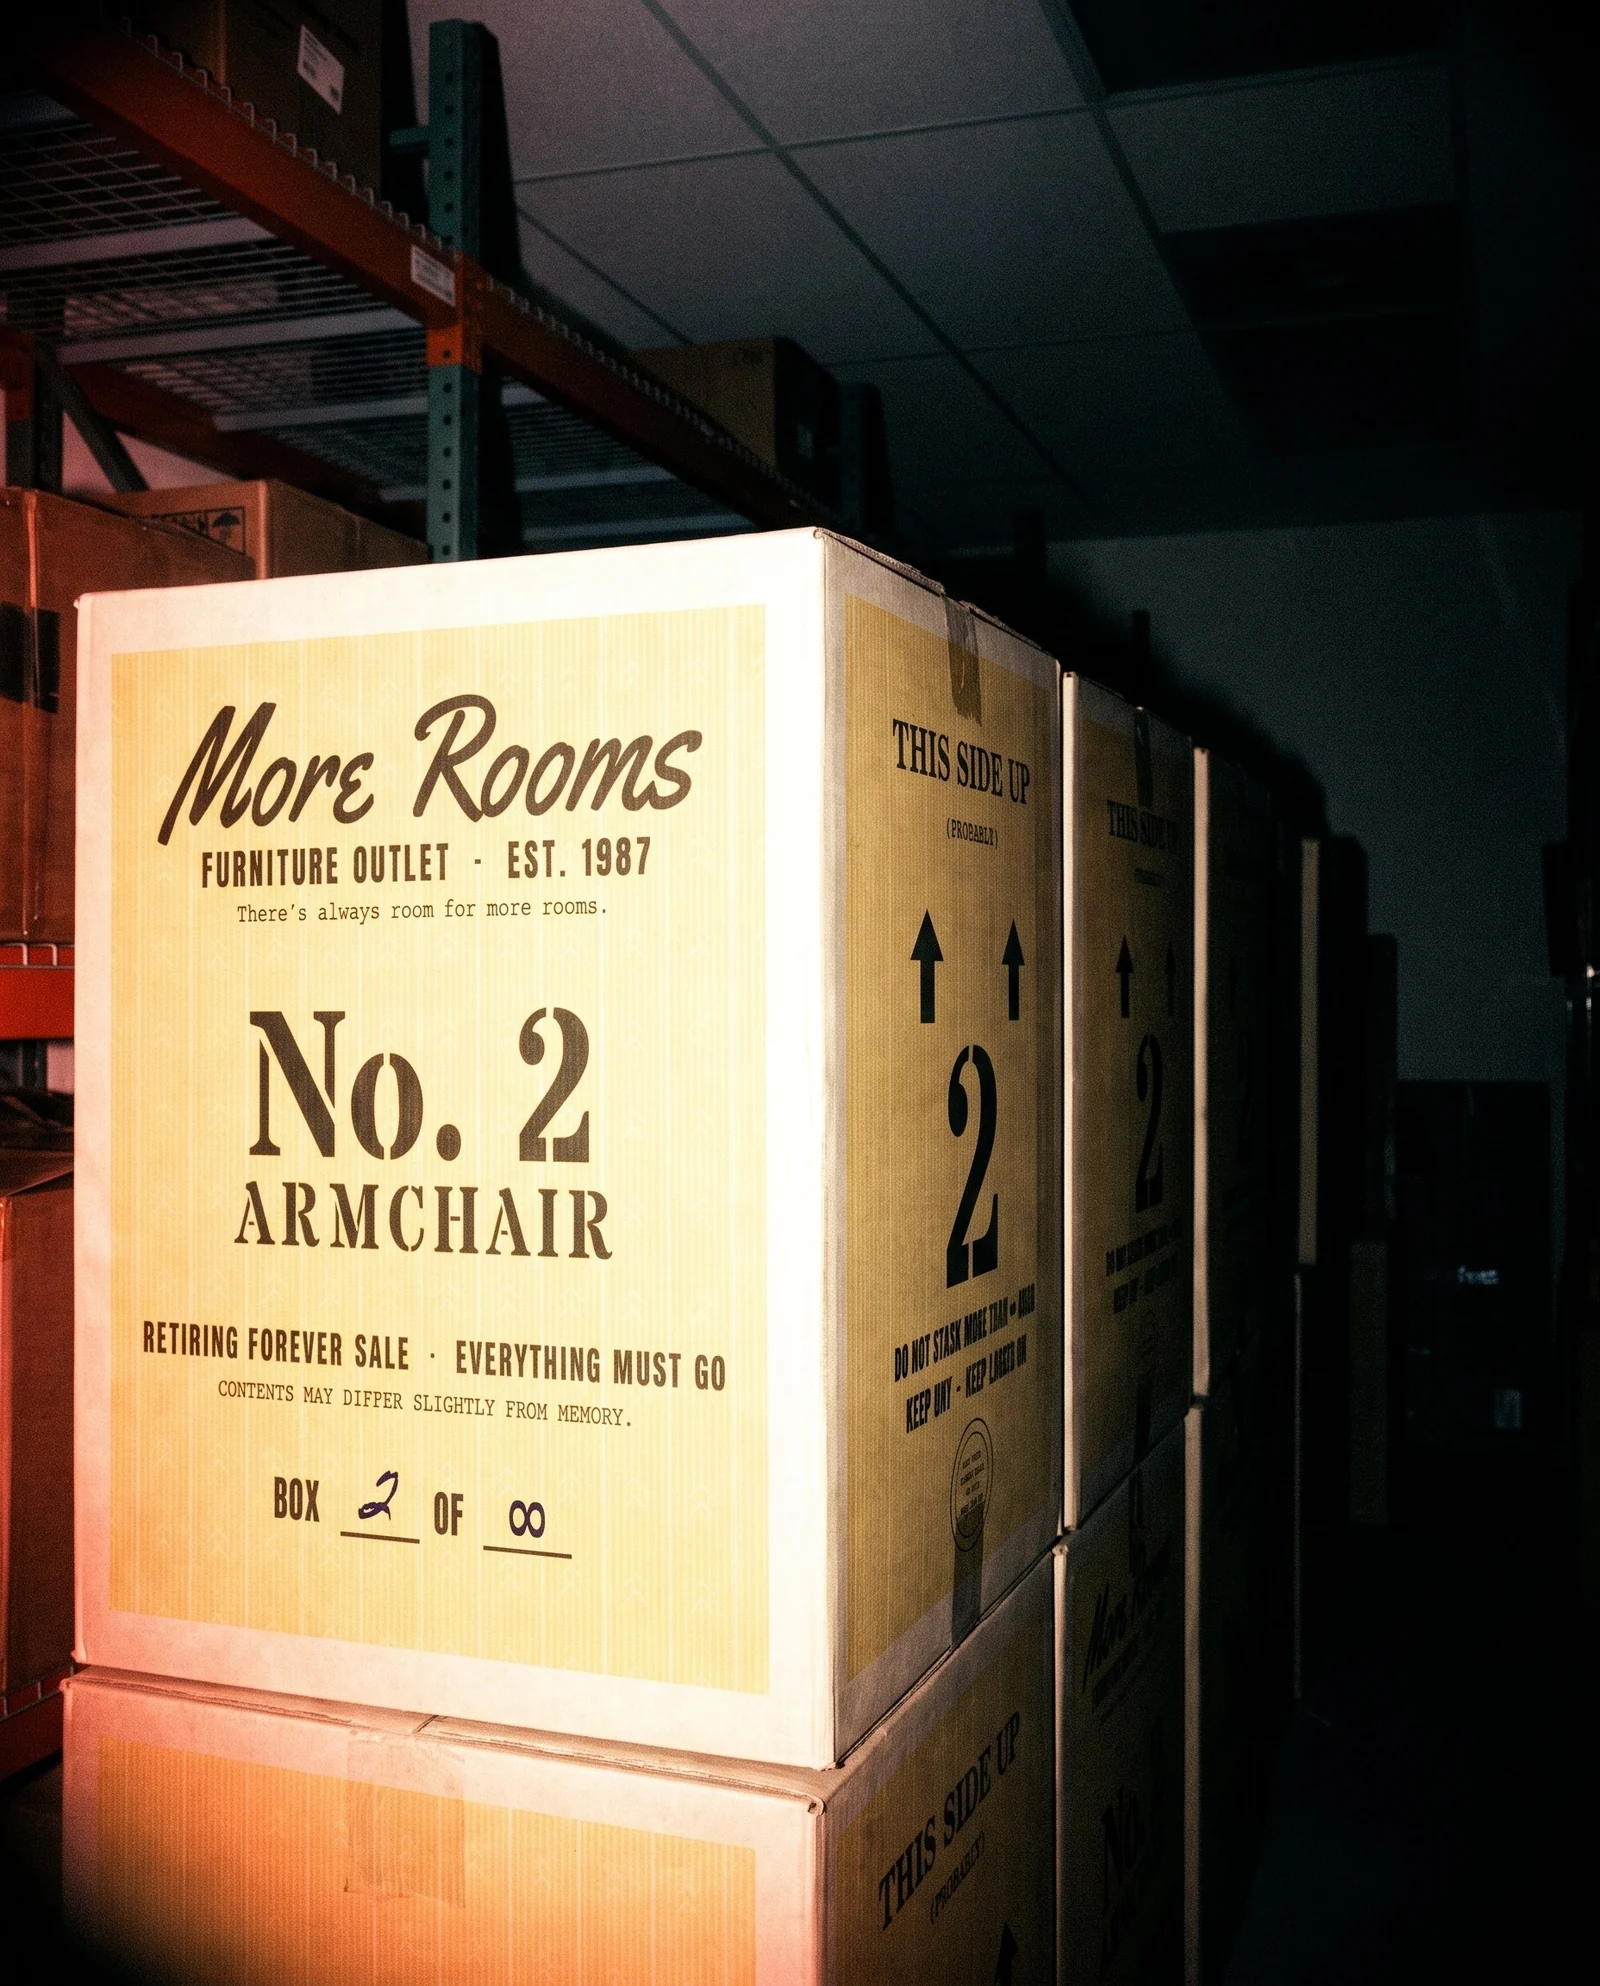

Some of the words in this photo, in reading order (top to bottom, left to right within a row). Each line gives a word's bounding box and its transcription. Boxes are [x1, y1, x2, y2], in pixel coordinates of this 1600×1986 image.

[157, 701, 374, 846] More
[412, 694, 703, 823] Rooms
[892, 718, 950, 782] THIS
[957, 740, 1003, 797] SIDE
[1008, 758, 1030, 804] UP
[201, 846, 338, 888] FURNITURE
[353, 843, 449, 883] OUTLET
[508, 838, 567, 879] EST.
[582, 835, 652, 876] 1987
[237, 904, 307, 922] There's
[318, 902, 380, 925] always
[391, 904, 434, 919] room
[445, 898, 476, 917] for
[487, 901, 531, 916] more
[543, 900, 606, 915] rooms.
[249, 1010, 462, 1162] No.
[518, 1007, 590, 1164] 2
[1136, 1034, 1163, 1214] 2
[947, 1045, 998, 1289] 2
[234, 1180, 614, 1261] ARMCHAIR
[143, 1320, 239, 1360] RETIRING
[248, 1327, 342, 1367] FOREVER
[354, 1334, 410, 1371] SALE
[456, 1340, 601, 1385] EVERYTHING
[613, 1348, 681, 1389] MUST
[694, 1354, 727, 1392] GO
[895, 1343, 909, 1383] DO
[912, 1333, 931, 1374] NOT
[906, 1388, 931, 1434] KEEP
[966, 1357, 987, 1399] KEEP
[218, 1380, 294, 1402] CONTENTS
[303, 1386, 333, 1405] MAY
[413, 1393, 495, 1417] SLIGHTLY
[505, 1400, 548, 1421] FROM
[557, 1404, 632, 1427] MEMORY.
[273, 1476, 320, 1523] BOX
[357, 1470, 399, 1521] 2
[434, 1491, 464, 1536] OF
[878, 1814, 936, 1932] THIS
[944, 1745, 991, 1849] SIDE
[996, 1711, 1020, 1776] UP
